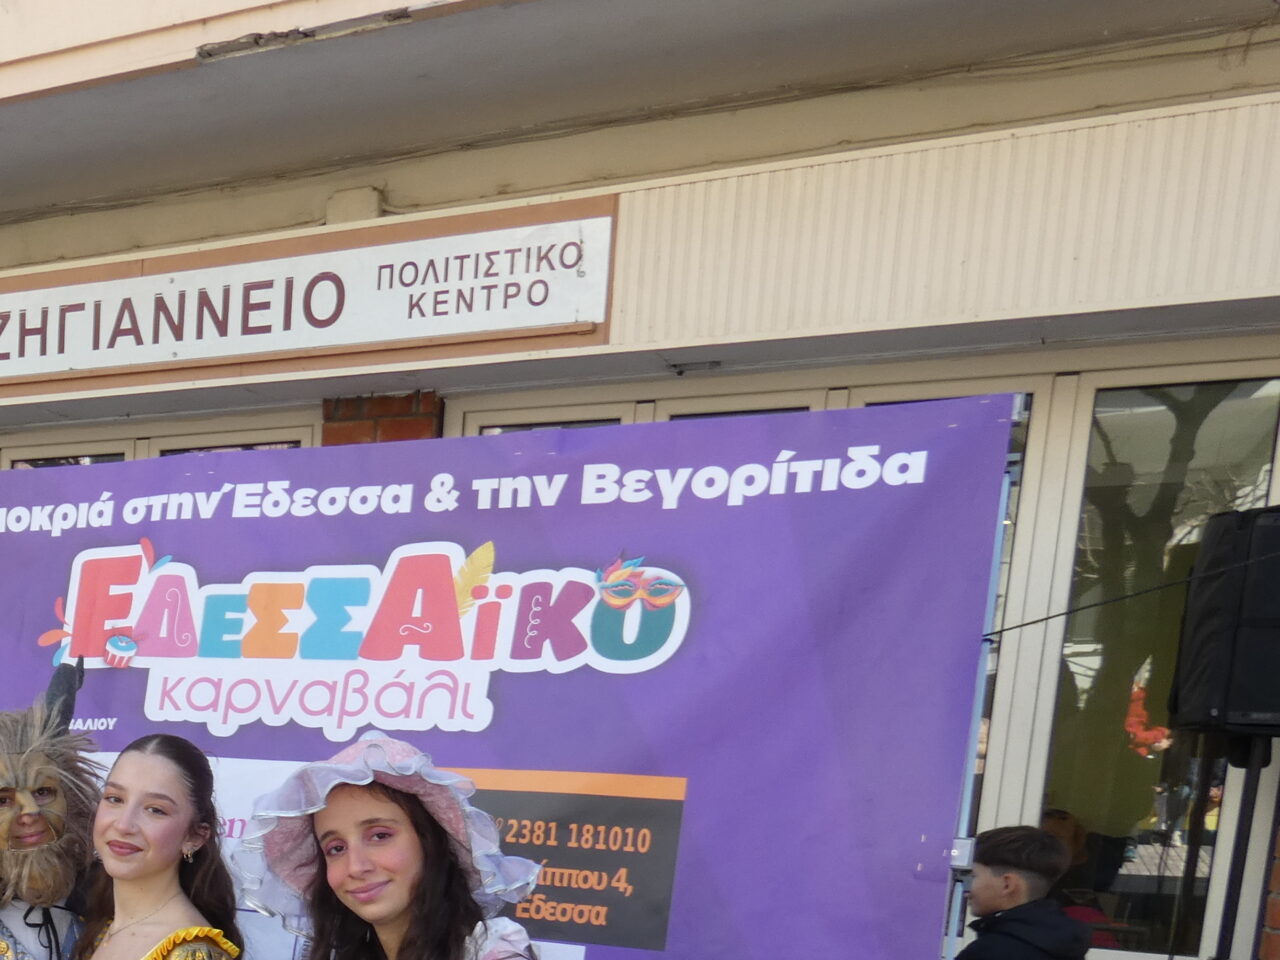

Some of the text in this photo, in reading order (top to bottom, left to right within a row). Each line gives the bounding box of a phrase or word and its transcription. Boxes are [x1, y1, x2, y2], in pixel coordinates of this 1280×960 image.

[376, 241, 583, 291] ΠΟΛΙΤΙΣΤΙΚΟ
[407, 279, 549, 319] ΚΕΝΤΡΟ
[122, 491, 222, 525] στην
[217, 480, 414, 518] Έδεσσα
[424, 472, 461, 512] &
[472, 472, 569, 510] την
[580, 444, 929, 510] Βεγορίτιδα
[157, 668, 477, 730] καρναβάλι
[505, 818, 653, 854] 2381 181010
[611, 867, 635, 897] 4,
